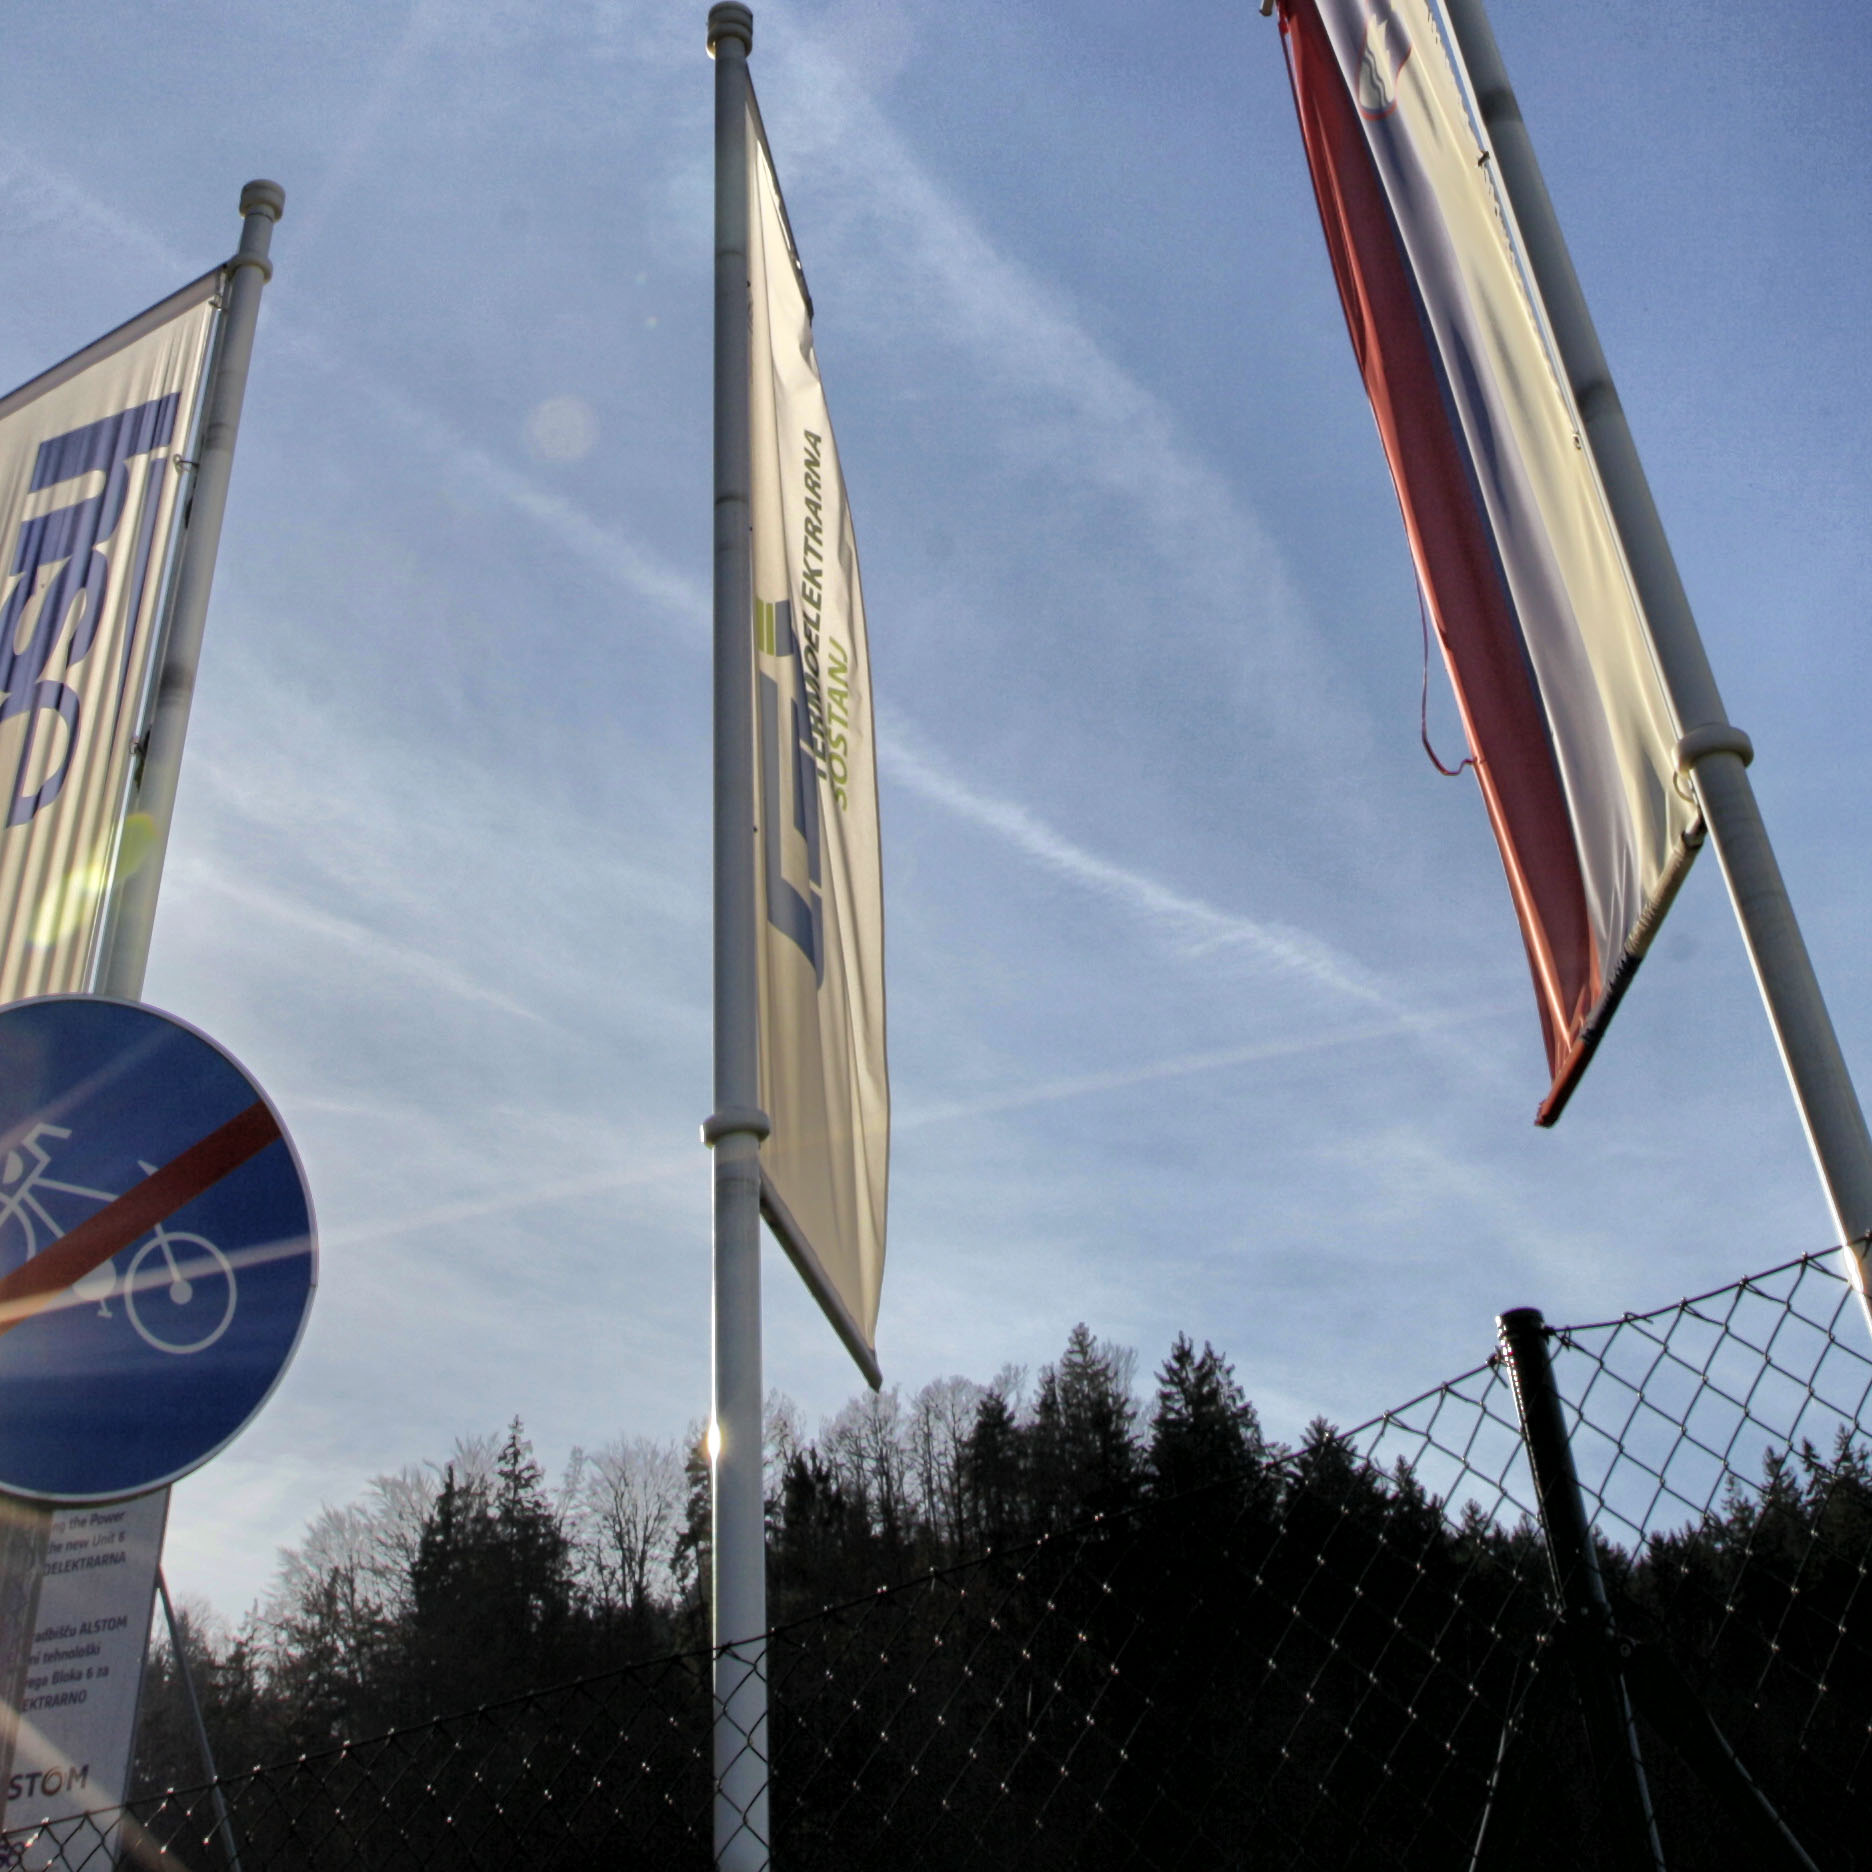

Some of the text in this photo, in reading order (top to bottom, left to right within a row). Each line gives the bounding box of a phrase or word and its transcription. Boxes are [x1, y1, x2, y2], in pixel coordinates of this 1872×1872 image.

[79, 1614, 128, 1636] ALSTOM
[22, 1689, 88, 1713] EKTRARNO
[7, 1763, 90, 1800] STOM
